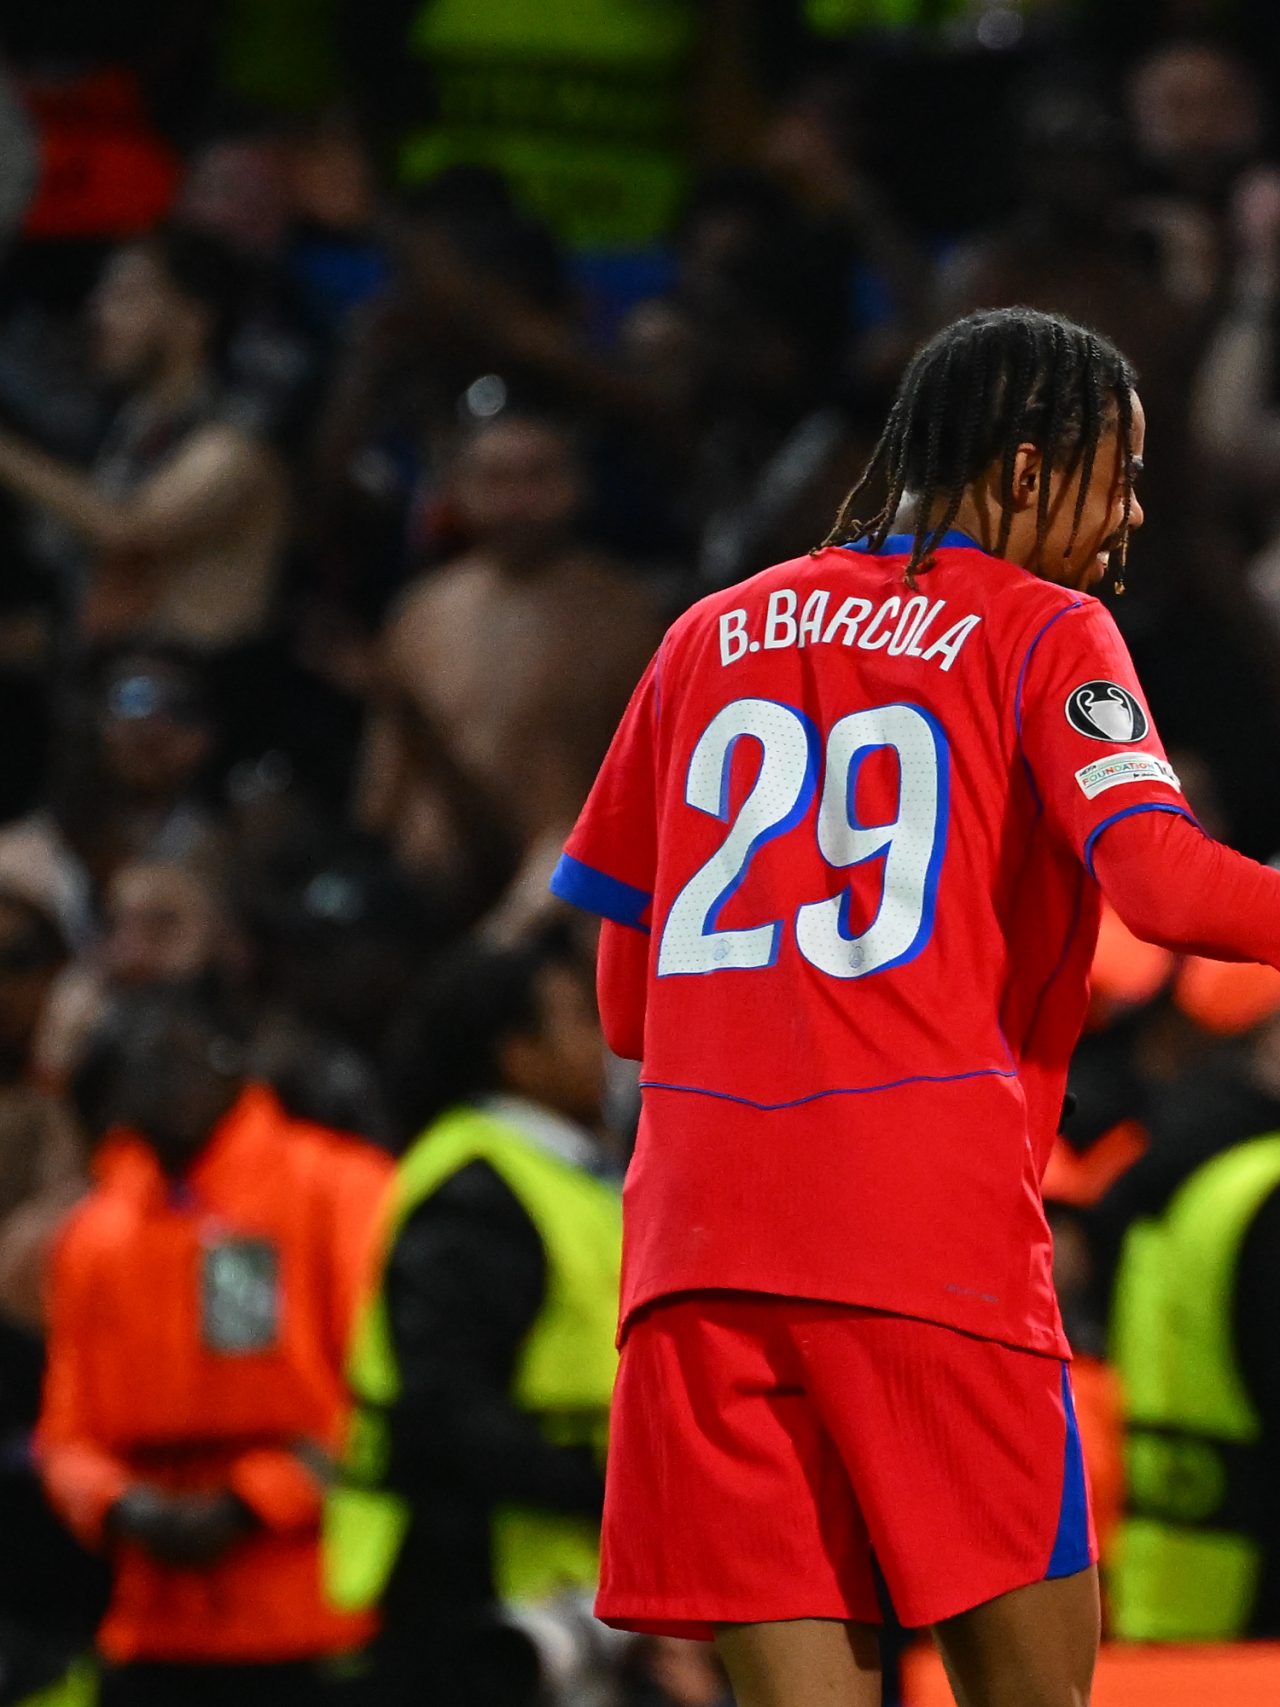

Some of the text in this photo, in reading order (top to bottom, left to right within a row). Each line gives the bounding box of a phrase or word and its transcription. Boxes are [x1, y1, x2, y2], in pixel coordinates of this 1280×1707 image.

[719, 588, 981, 672] B.BARCOLA
[1081, 762, 1155, 787] FOUNDATION
[657, 697, 950, 979] 29
